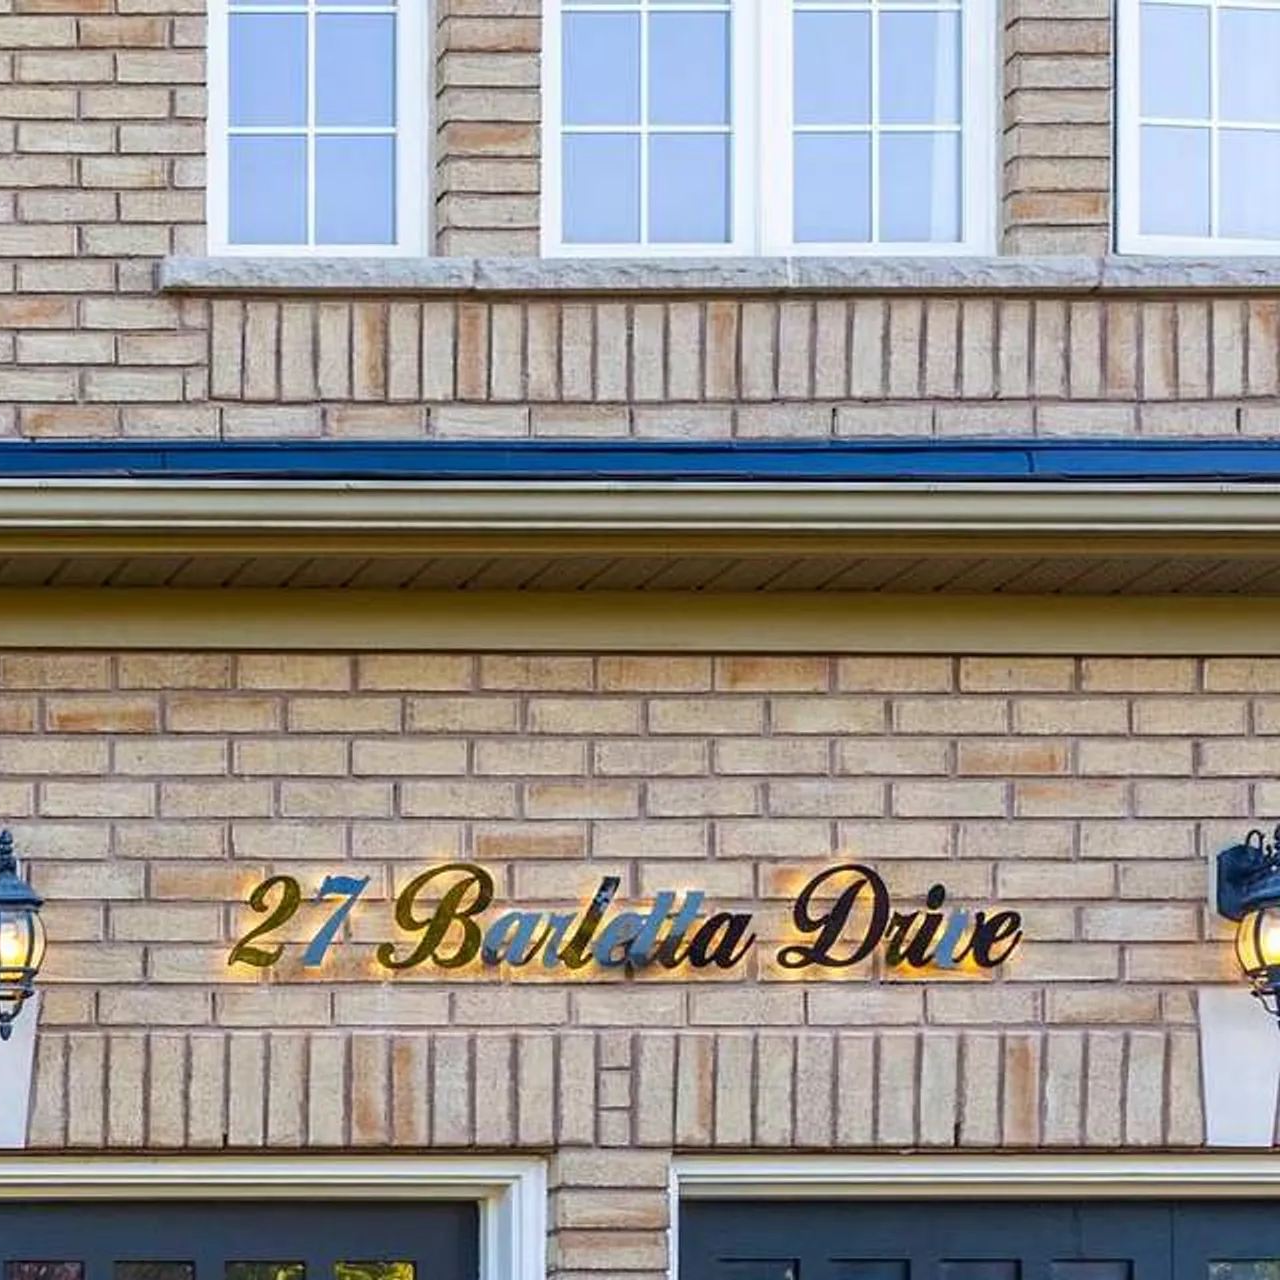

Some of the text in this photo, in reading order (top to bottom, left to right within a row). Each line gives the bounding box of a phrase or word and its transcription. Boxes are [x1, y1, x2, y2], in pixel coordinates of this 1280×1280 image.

[230, 863, 1023, 971] 27 Barletta Drive
